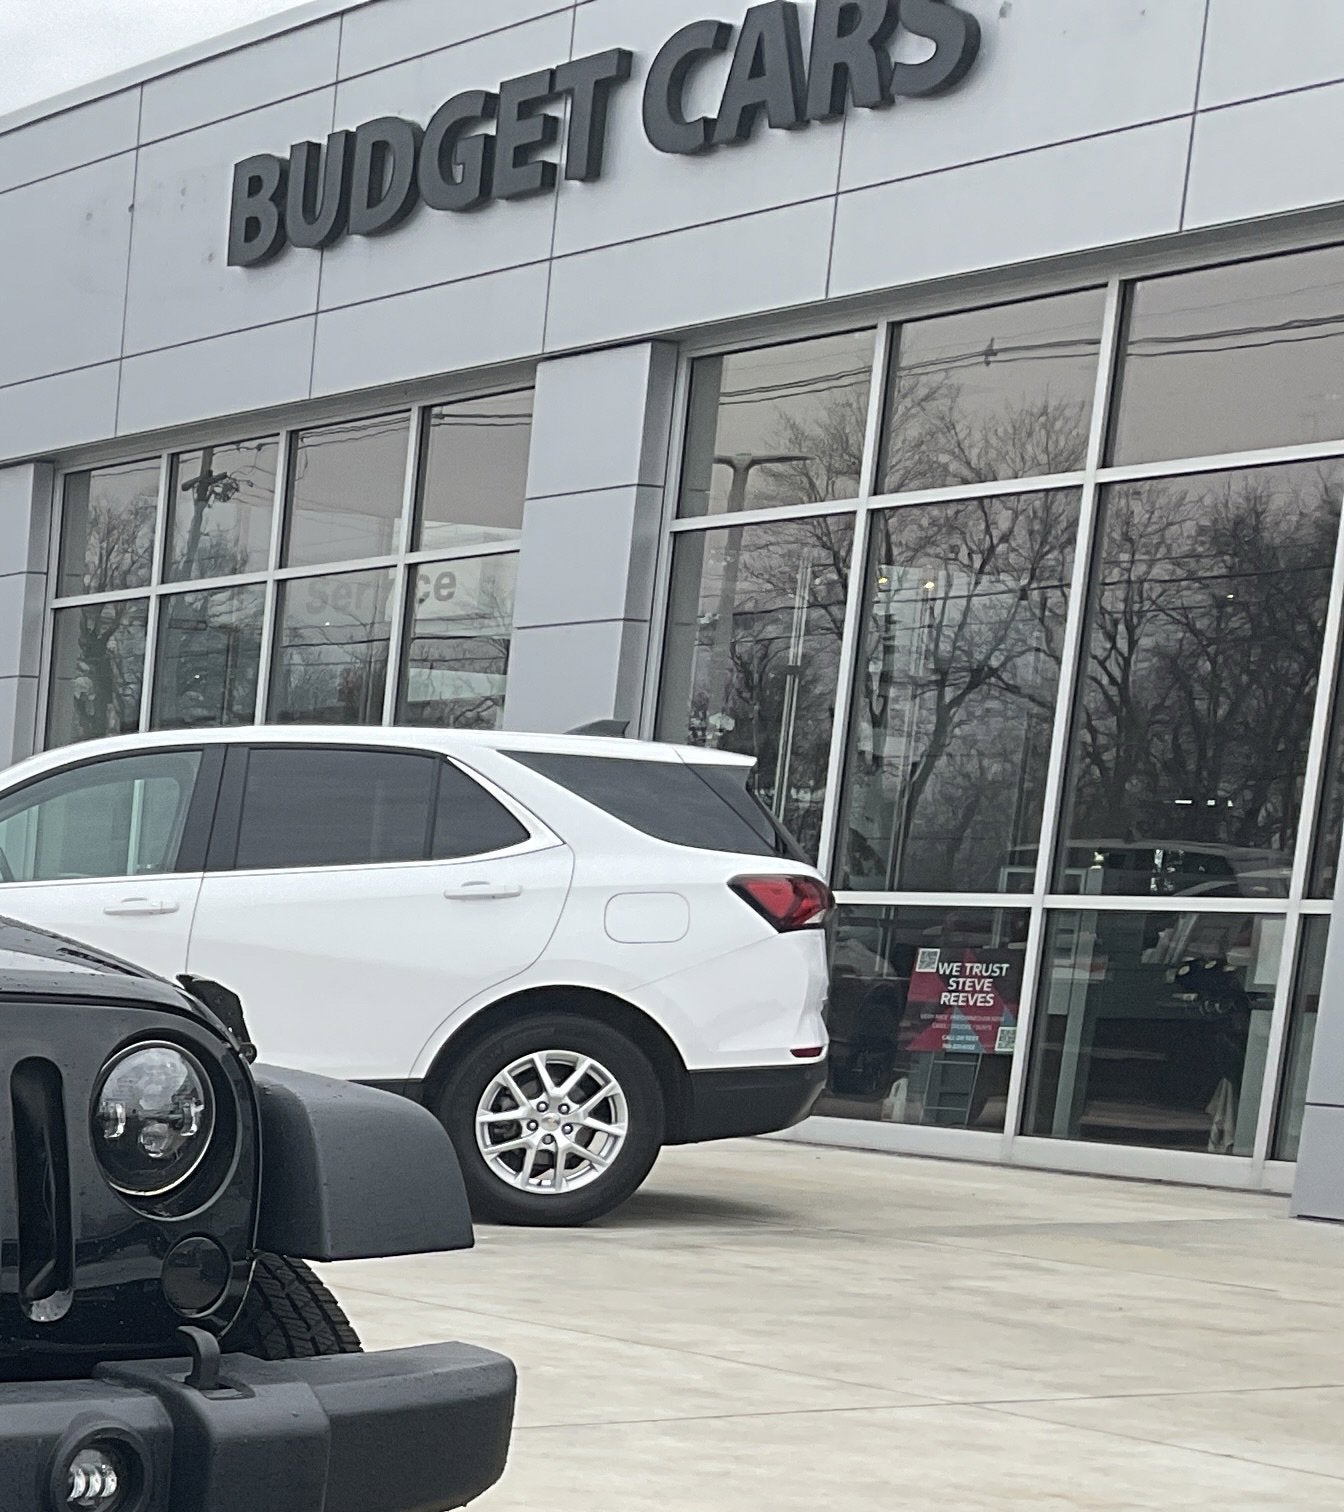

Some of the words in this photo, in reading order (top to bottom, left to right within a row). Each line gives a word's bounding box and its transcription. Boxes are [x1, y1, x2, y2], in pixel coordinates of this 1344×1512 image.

[228, 48, 632, 267] BUDGET
[642, 0, 981, 154] CARS
[938, 962, 962, 975] WE
[964, 963, 1010, 977] TRUST
[947, 978, 994, 991] STEVE
[940, 992, 995, 1007] REEVES
